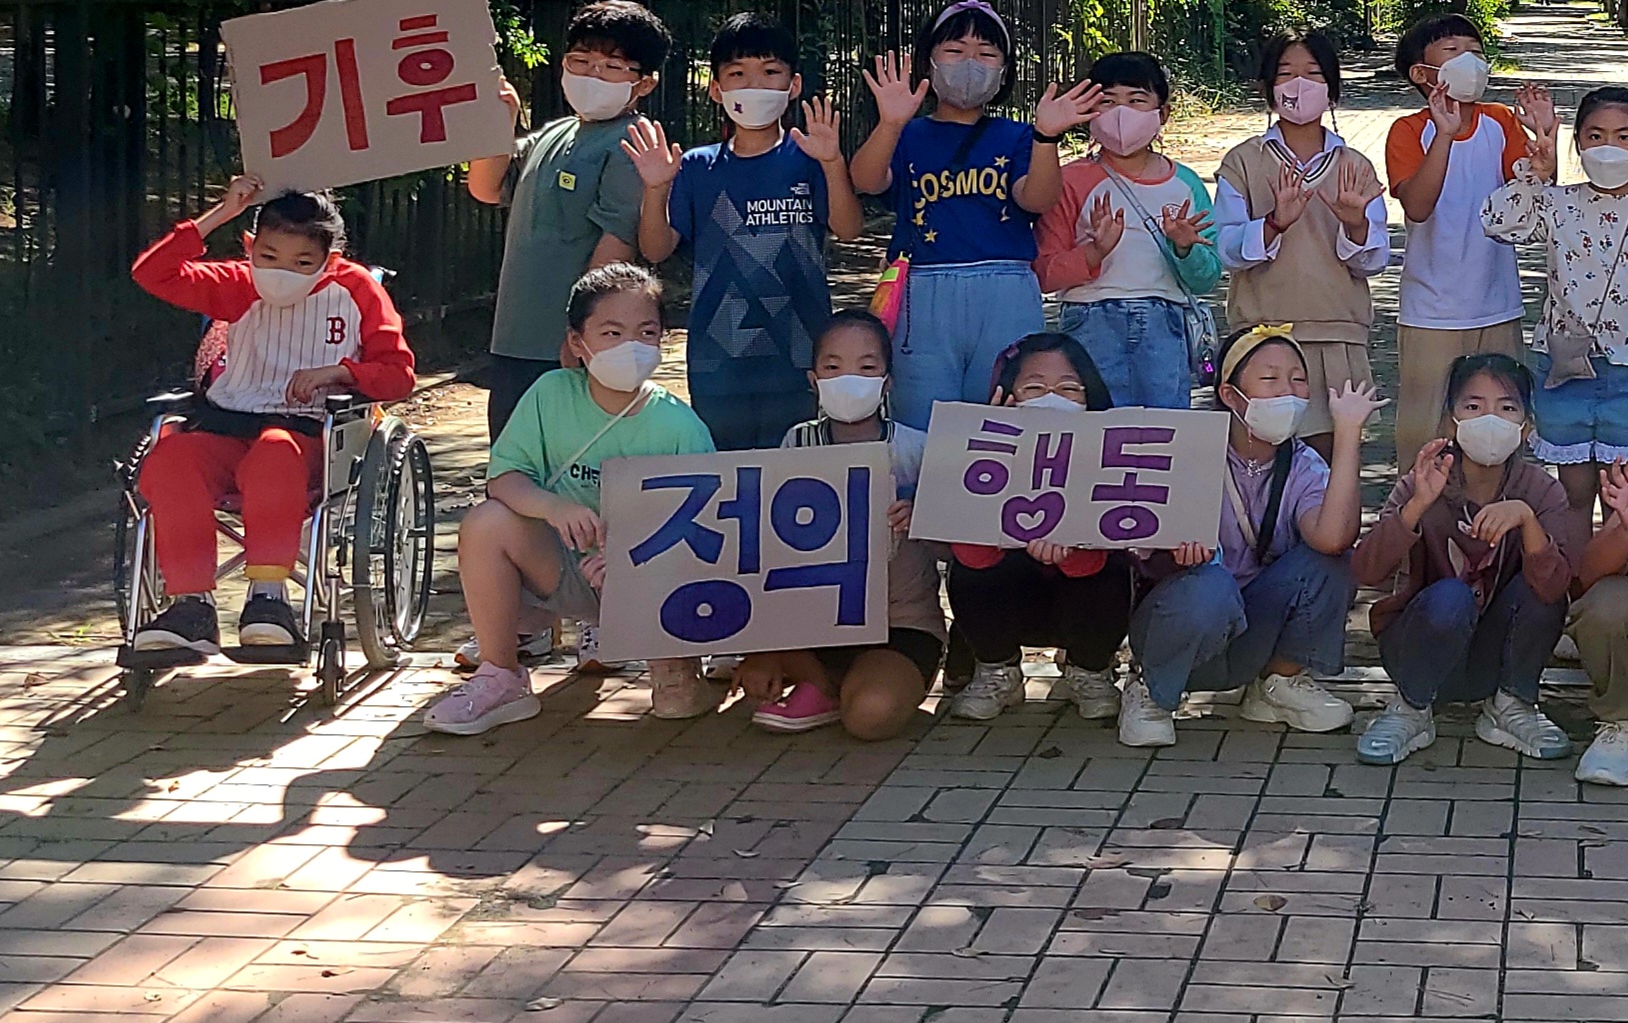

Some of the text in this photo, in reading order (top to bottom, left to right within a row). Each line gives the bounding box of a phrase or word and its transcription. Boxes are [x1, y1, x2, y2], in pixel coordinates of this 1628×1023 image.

[260, 14, 477, 159] 기후
[745, 211, 813, 226] ATHLETICS
[746, 198, 813, 213] MOUNTAIN
[325, 317, 346, 344] B
[963, 419, 1177, 542] 행동
